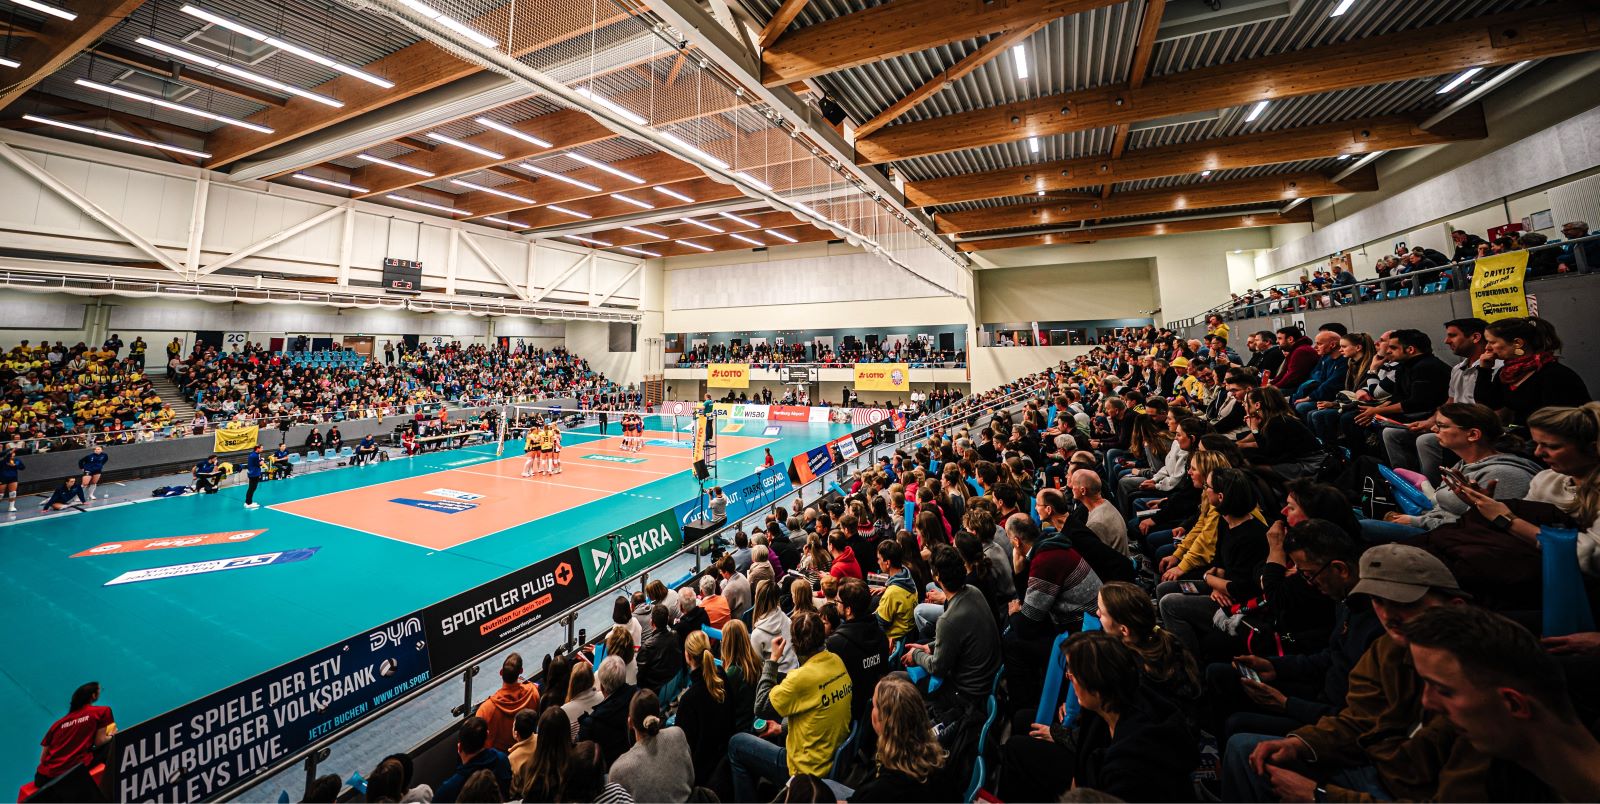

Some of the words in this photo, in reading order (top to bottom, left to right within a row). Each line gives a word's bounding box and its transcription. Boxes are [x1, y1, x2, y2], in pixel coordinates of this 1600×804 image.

[227, 333, 245, 343] 2C
[720, 370, 742, 378] LOTTO
[224, 439, 237, 447] SSC
[726, 491, 742, 507] AUT.
[617, 523, 673, 565] DEKRA
[441, 588, 520, 636] SPORTLER
[521, 572, 555, 599] PLUS
[483, 614, 512, 632] Nutrition
[512, 610, 521, 620] für
[522, 604, 535, 613] dein
[536, 597, 550, 606] Team
[862, 653, 881, 669] COACH
[373, 670, 430, 706] WWW.DYN.SPORT
[120, 722, 183, 773] ALLE
[190, 688, 264, 740] SPIELE
[268, 671, 306, 706] DER
[310, 655, 341, 686] ETV
[308, 721, 332, 741] JETZT
[334, 702, 369, 727] BUCHEN!
[120, 714, 269, 803] HAMBURGER
[273, 664, 377, 729] VOLKSBANK
[237, 734, 288, 777] LIVE.
